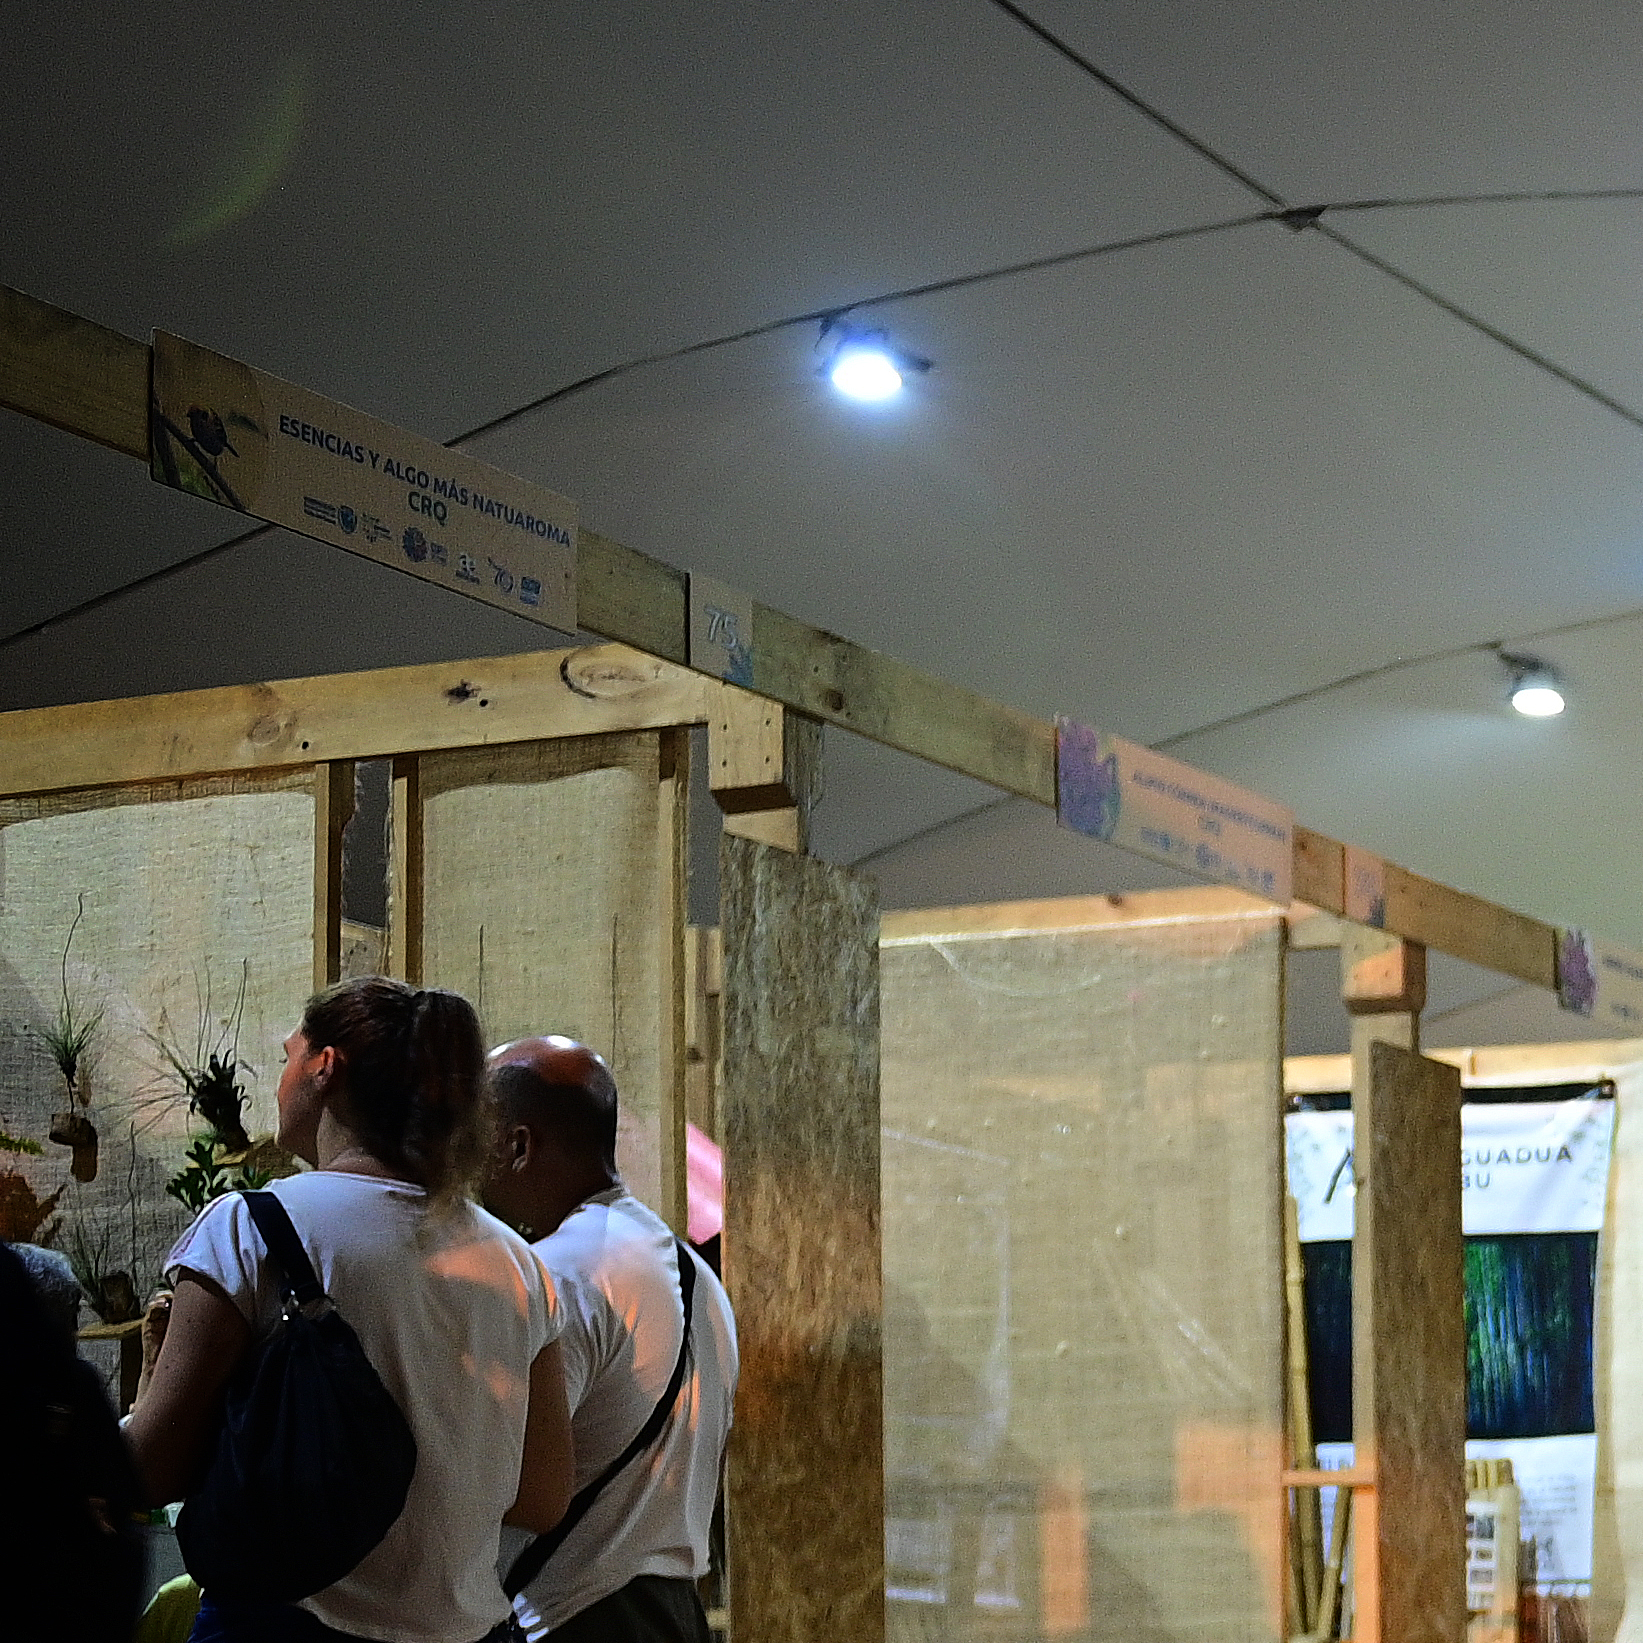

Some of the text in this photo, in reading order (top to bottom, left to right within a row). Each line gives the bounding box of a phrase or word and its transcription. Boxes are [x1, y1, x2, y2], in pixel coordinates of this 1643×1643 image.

[279, 414, 571, 548] ESENCIAS Y ALGO MÁS NATUAROMA
[408, 491, 448, 526] CRQ
[703, 603, 738, 651] 75
